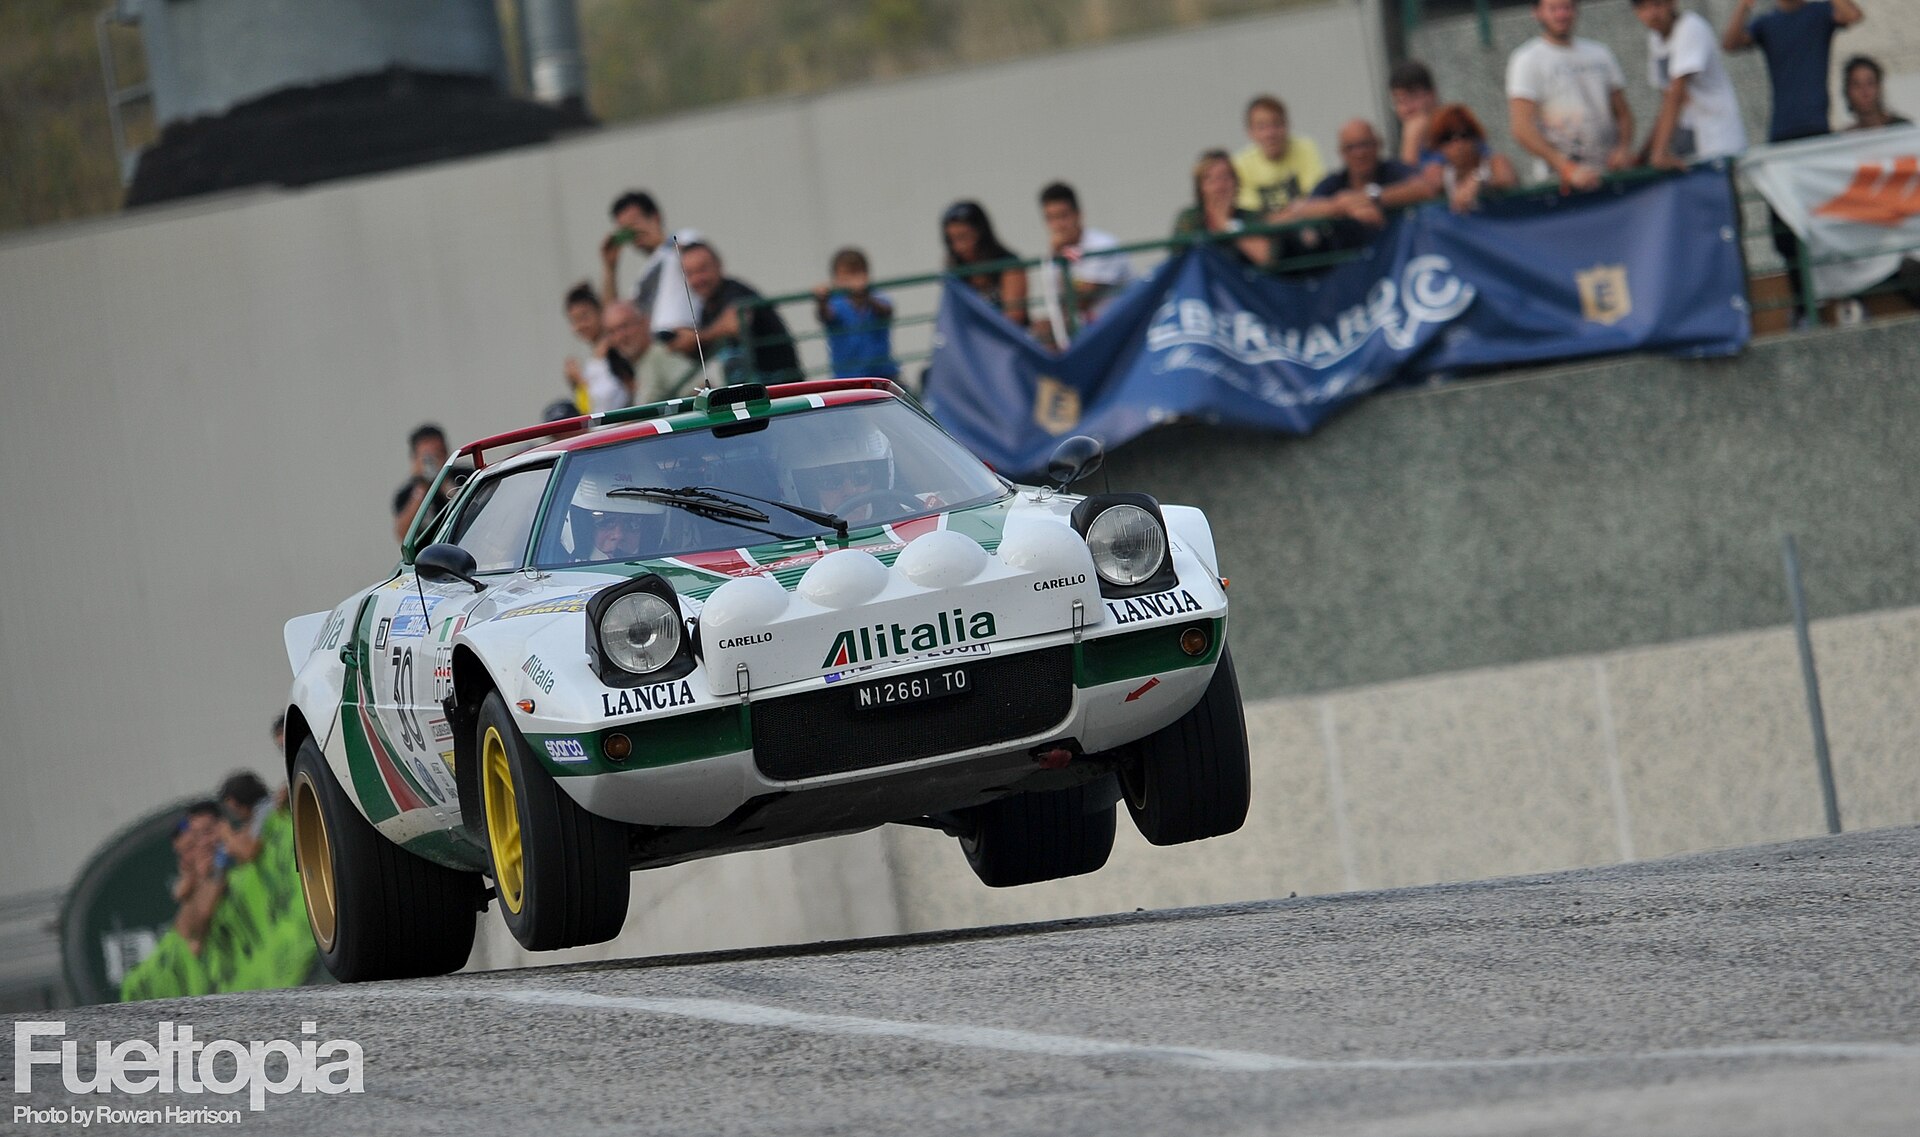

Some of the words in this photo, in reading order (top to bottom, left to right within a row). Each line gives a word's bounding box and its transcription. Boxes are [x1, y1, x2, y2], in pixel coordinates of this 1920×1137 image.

[1033, 573, 1087, 592] CARELLO
[1106, 589, 1203, 625] LANCIA
[718, 632, 774, 650] CARELLO
[821, 608, 998, 670] Alitalia
[521, 654, 555, 696] Alitalia
[859, 678, 931, 707] N12661
[942, 669, 967, 692] TO
[392, 645, 427, 753] 30
[601, 680, 696, 718] LANCIA
[544, 739, 584, 757] sparco
